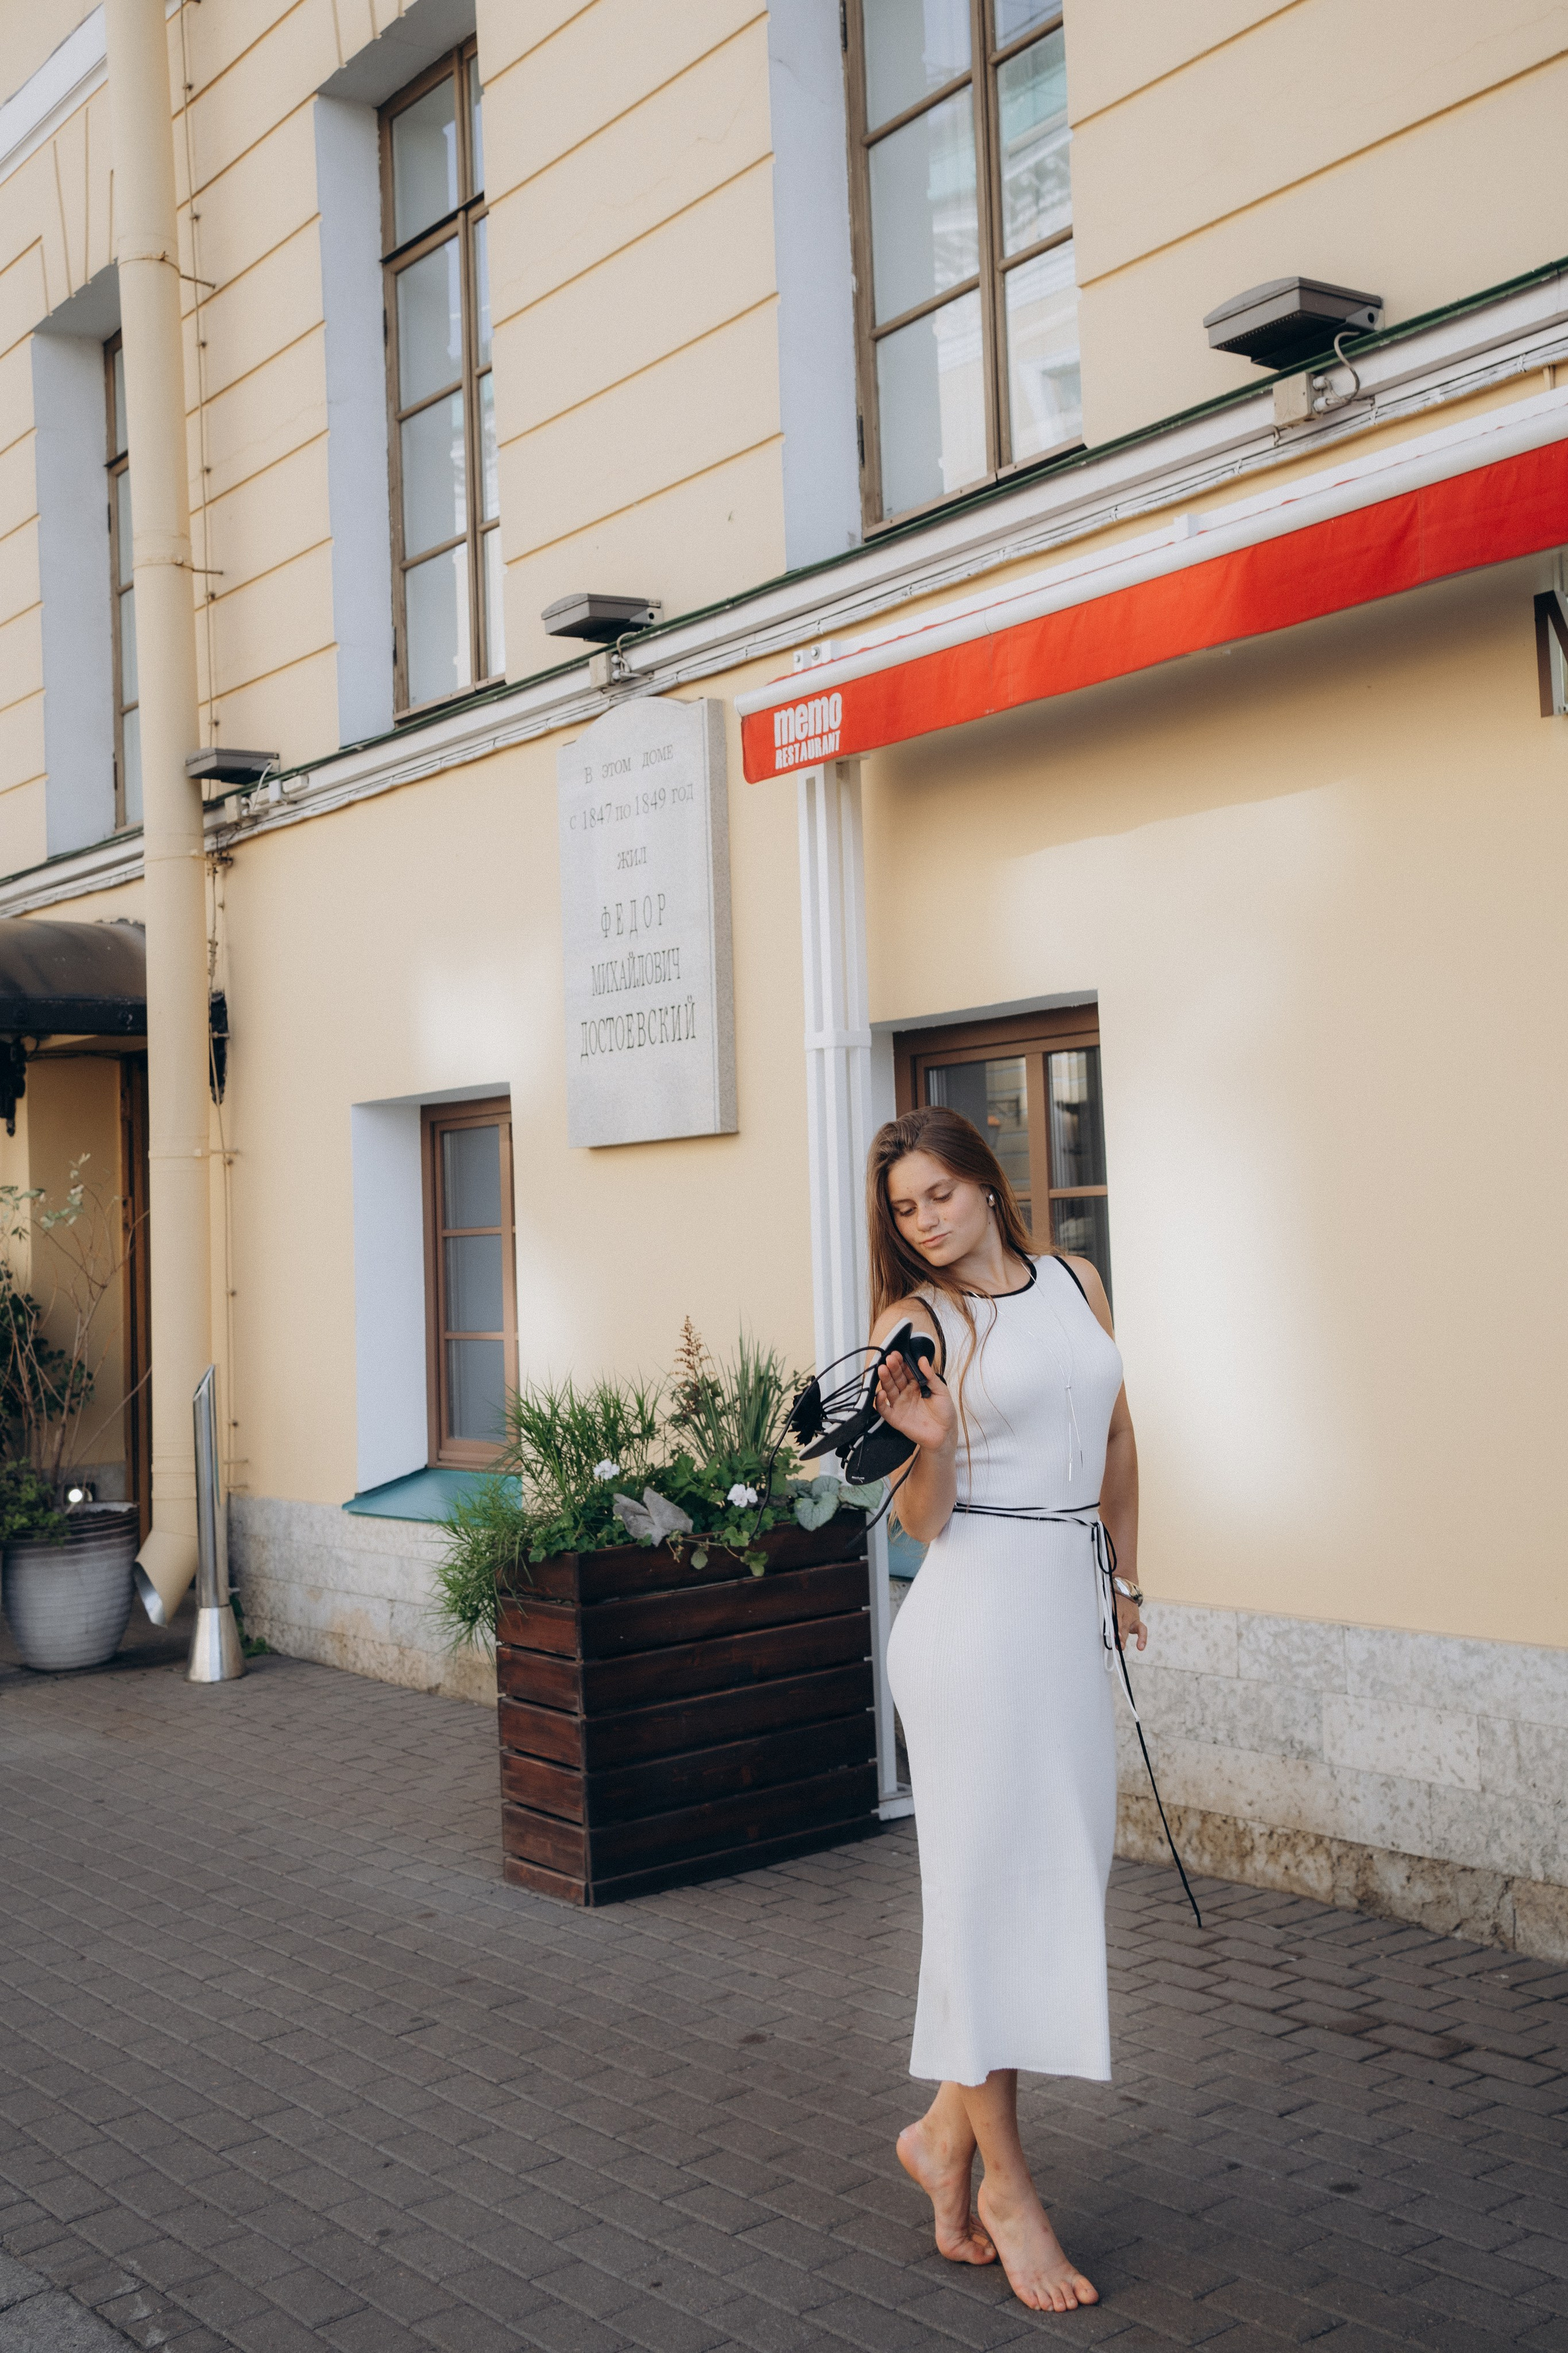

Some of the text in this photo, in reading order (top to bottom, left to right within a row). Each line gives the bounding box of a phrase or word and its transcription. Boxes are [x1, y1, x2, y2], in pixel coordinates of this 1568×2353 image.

[774, 692, 842, 748] memo
[584, 744, 674, 784] В ЭТОМ ДОМЕ
[775, 730, 841, 769] RESTAURANT
[582, 803, 612, 830] 1847
[635, 788, 666, 816] 1849
[617, 847, 647, 869] ЖИЛ
[601, 893, 666, 939] ФЕДОР
[592, 947, 680, 996] МИХАЙЛОВИЧ
[581, 995, 696, 1065] ДОСТОЕВСКИЙ
